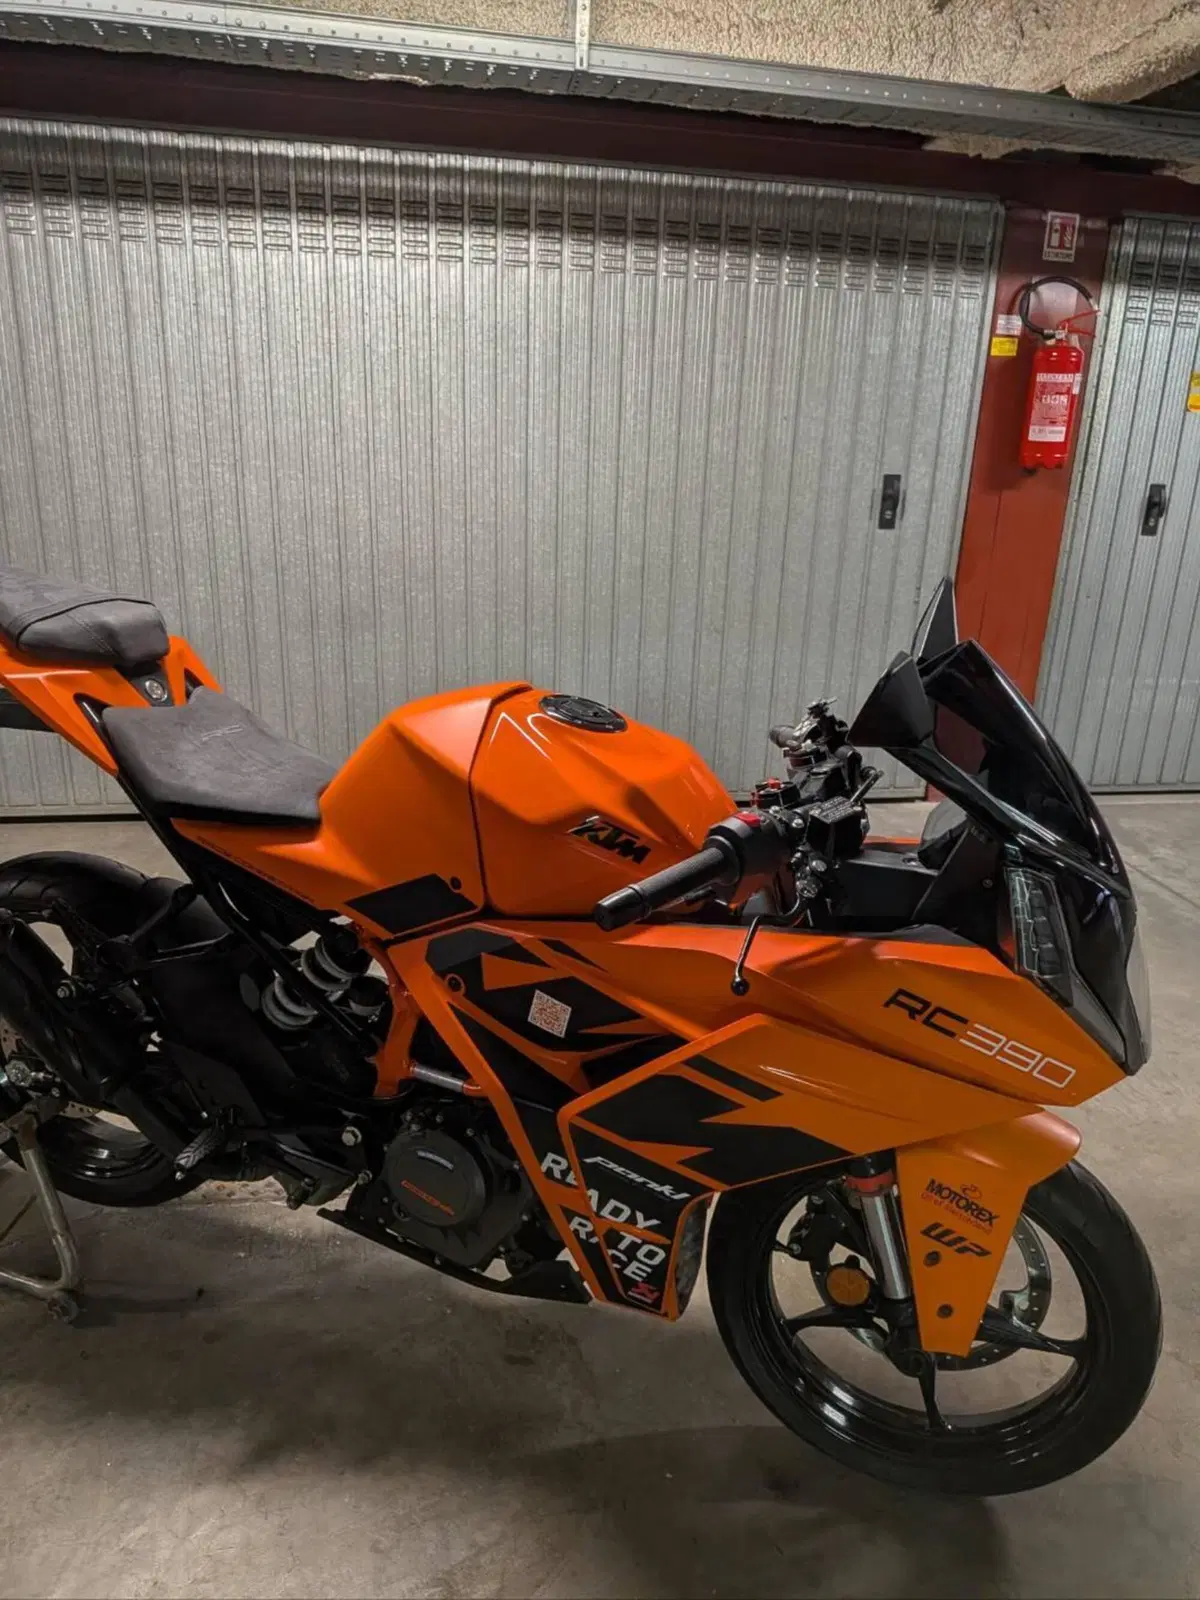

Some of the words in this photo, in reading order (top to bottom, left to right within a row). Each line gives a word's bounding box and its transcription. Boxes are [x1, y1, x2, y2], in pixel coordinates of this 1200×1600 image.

[567, 815, 651, 865] KTM
[925, 1178, 1000, 1226] MOTOREX
[616, 1231, 666, 1266] TO
[920, 1221, 992, 1257] WP
